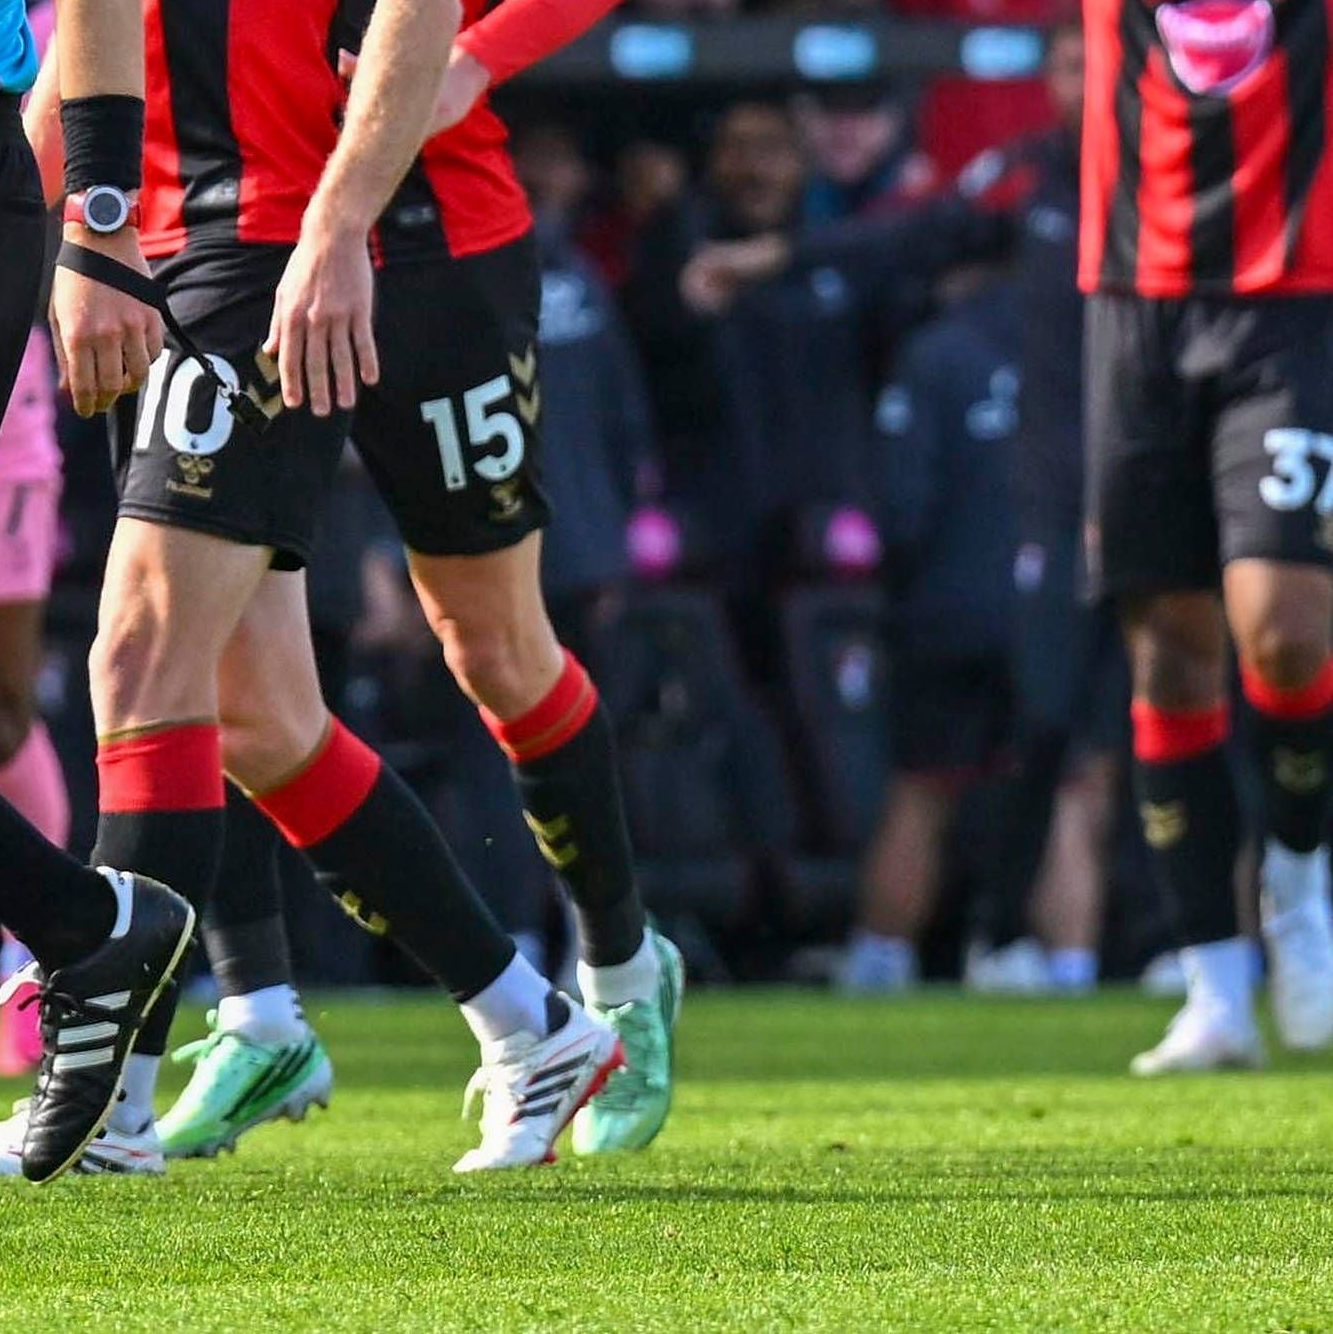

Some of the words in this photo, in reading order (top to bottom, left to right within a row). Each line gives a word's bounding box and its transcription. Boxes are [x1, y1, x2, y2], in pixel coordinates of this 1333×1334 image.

[135, 347, 240, 456] 10
[419, 373, 525, 493] 15
[1258, 427, 1333, 516] 37
